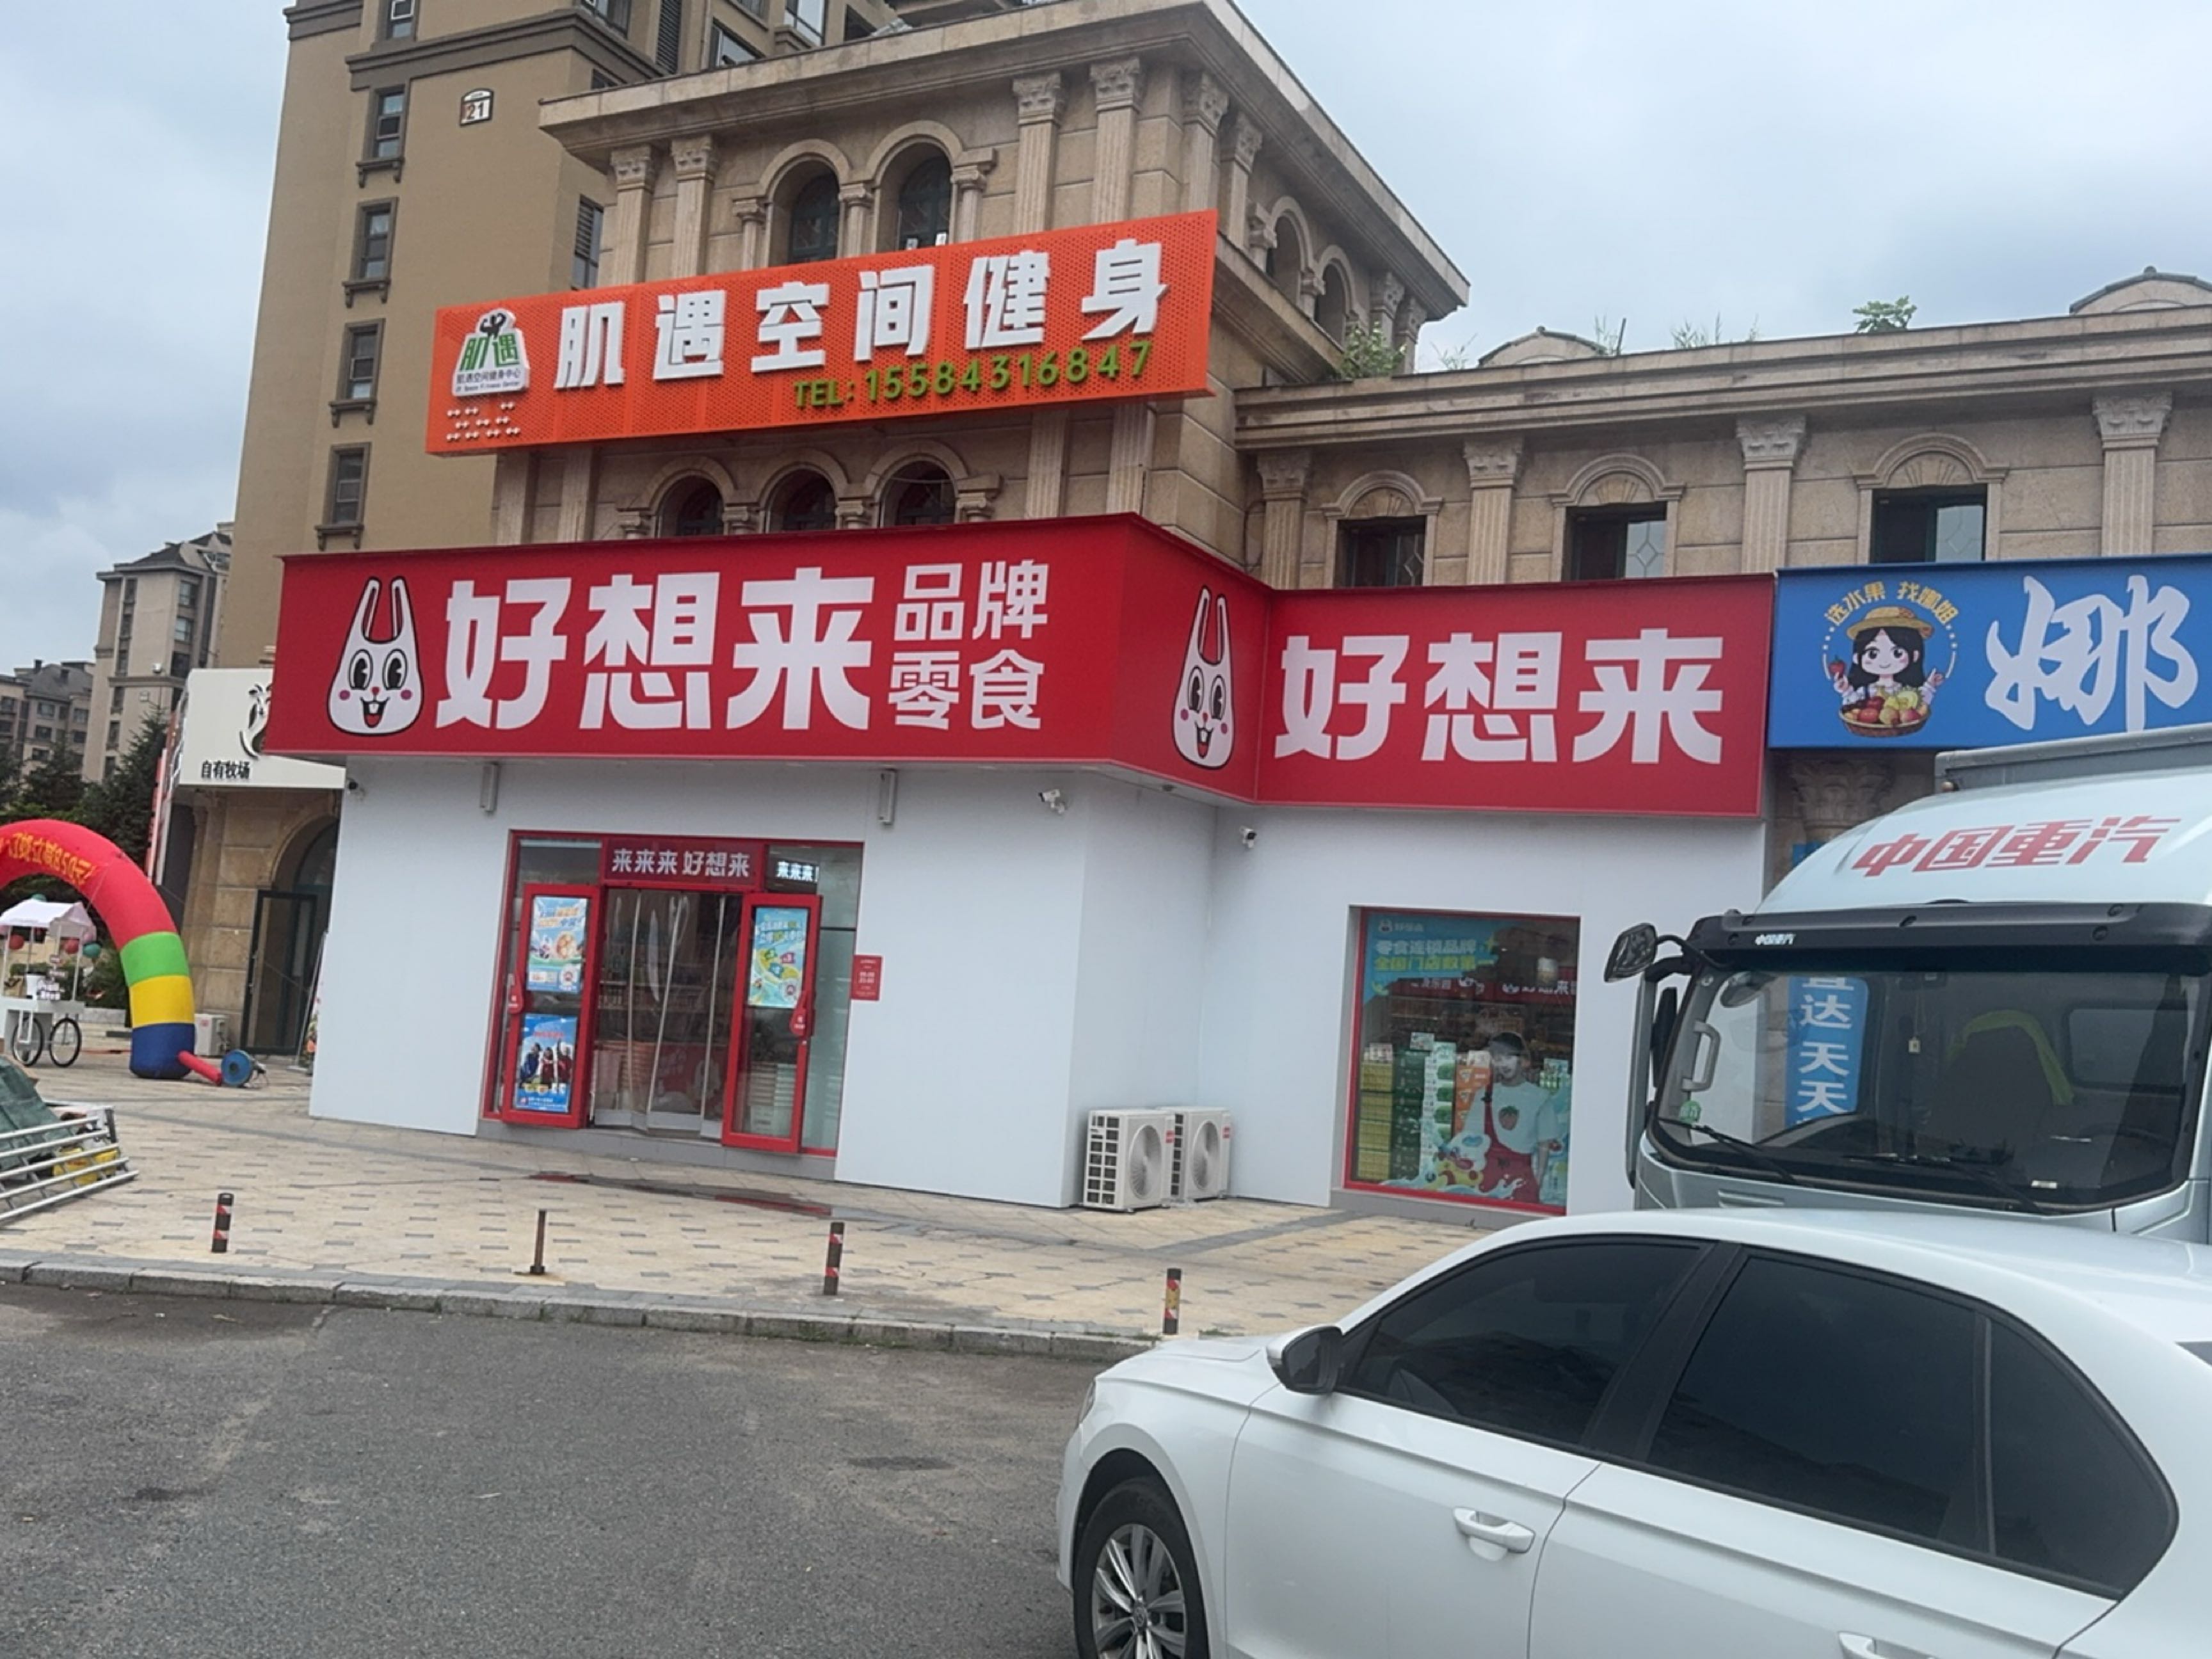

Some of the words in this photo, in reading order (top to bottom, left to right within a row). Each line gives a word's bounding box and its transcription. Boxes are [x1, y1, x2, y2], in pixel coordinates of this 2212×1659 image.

[466, 102, 484, 120] 21
[554, 238, 1169, 389] 肌遇空间健身
[459, 332, 520, 371] 肌遇
[893, 559, 1050, 641] 品牌
[435, 567, 874, 730] 好想来
[888, 648, 1045, 730] 零食
[1274, 628, 1723, 764] 好想来
[201, 760, 250, 780] 自有牧场
[612, 848, 678, 876] 来来来
[682, 851, 750, 878] 好想来
[1853, 815, 2180, 878] 中国重汽
